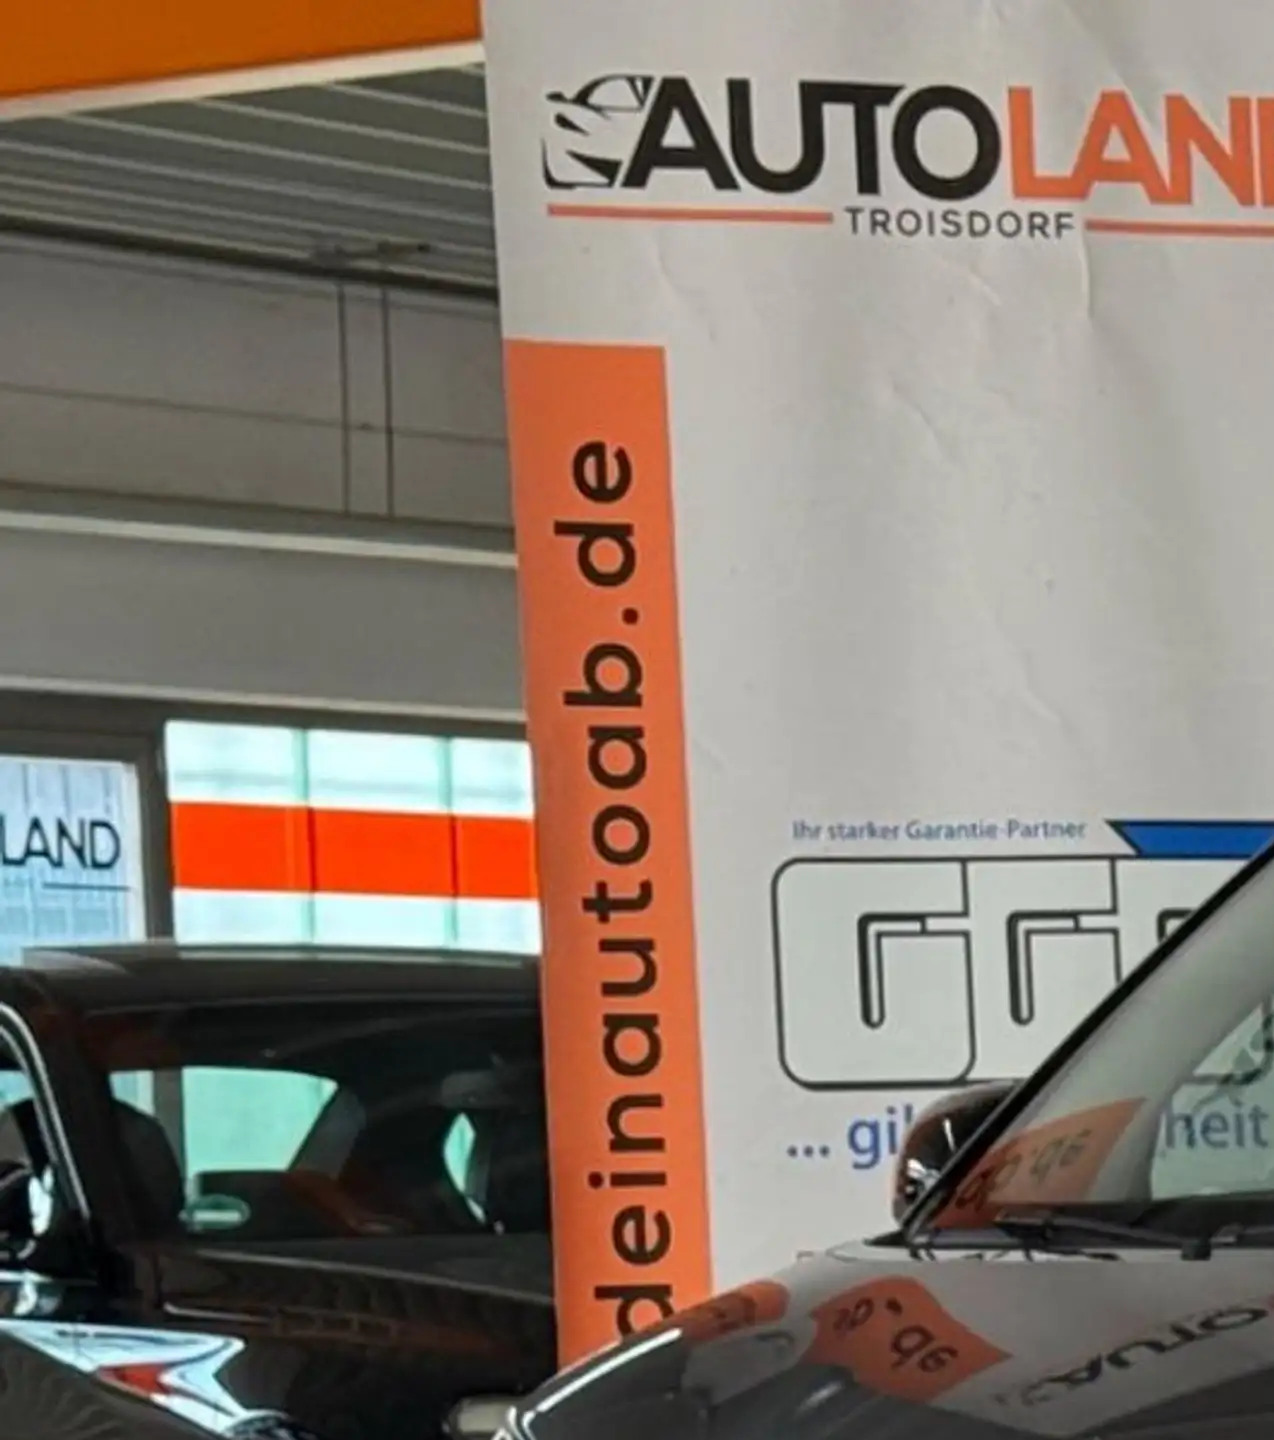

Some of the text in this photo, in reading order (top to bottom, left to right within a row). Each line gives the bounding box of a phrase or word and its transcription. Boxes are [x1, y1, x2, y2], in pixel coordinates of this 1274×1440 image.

[845, 206, 1076, 241] TROISDORF
[792, 817, 1087, 841] Ihr starker Garantie-Partner
